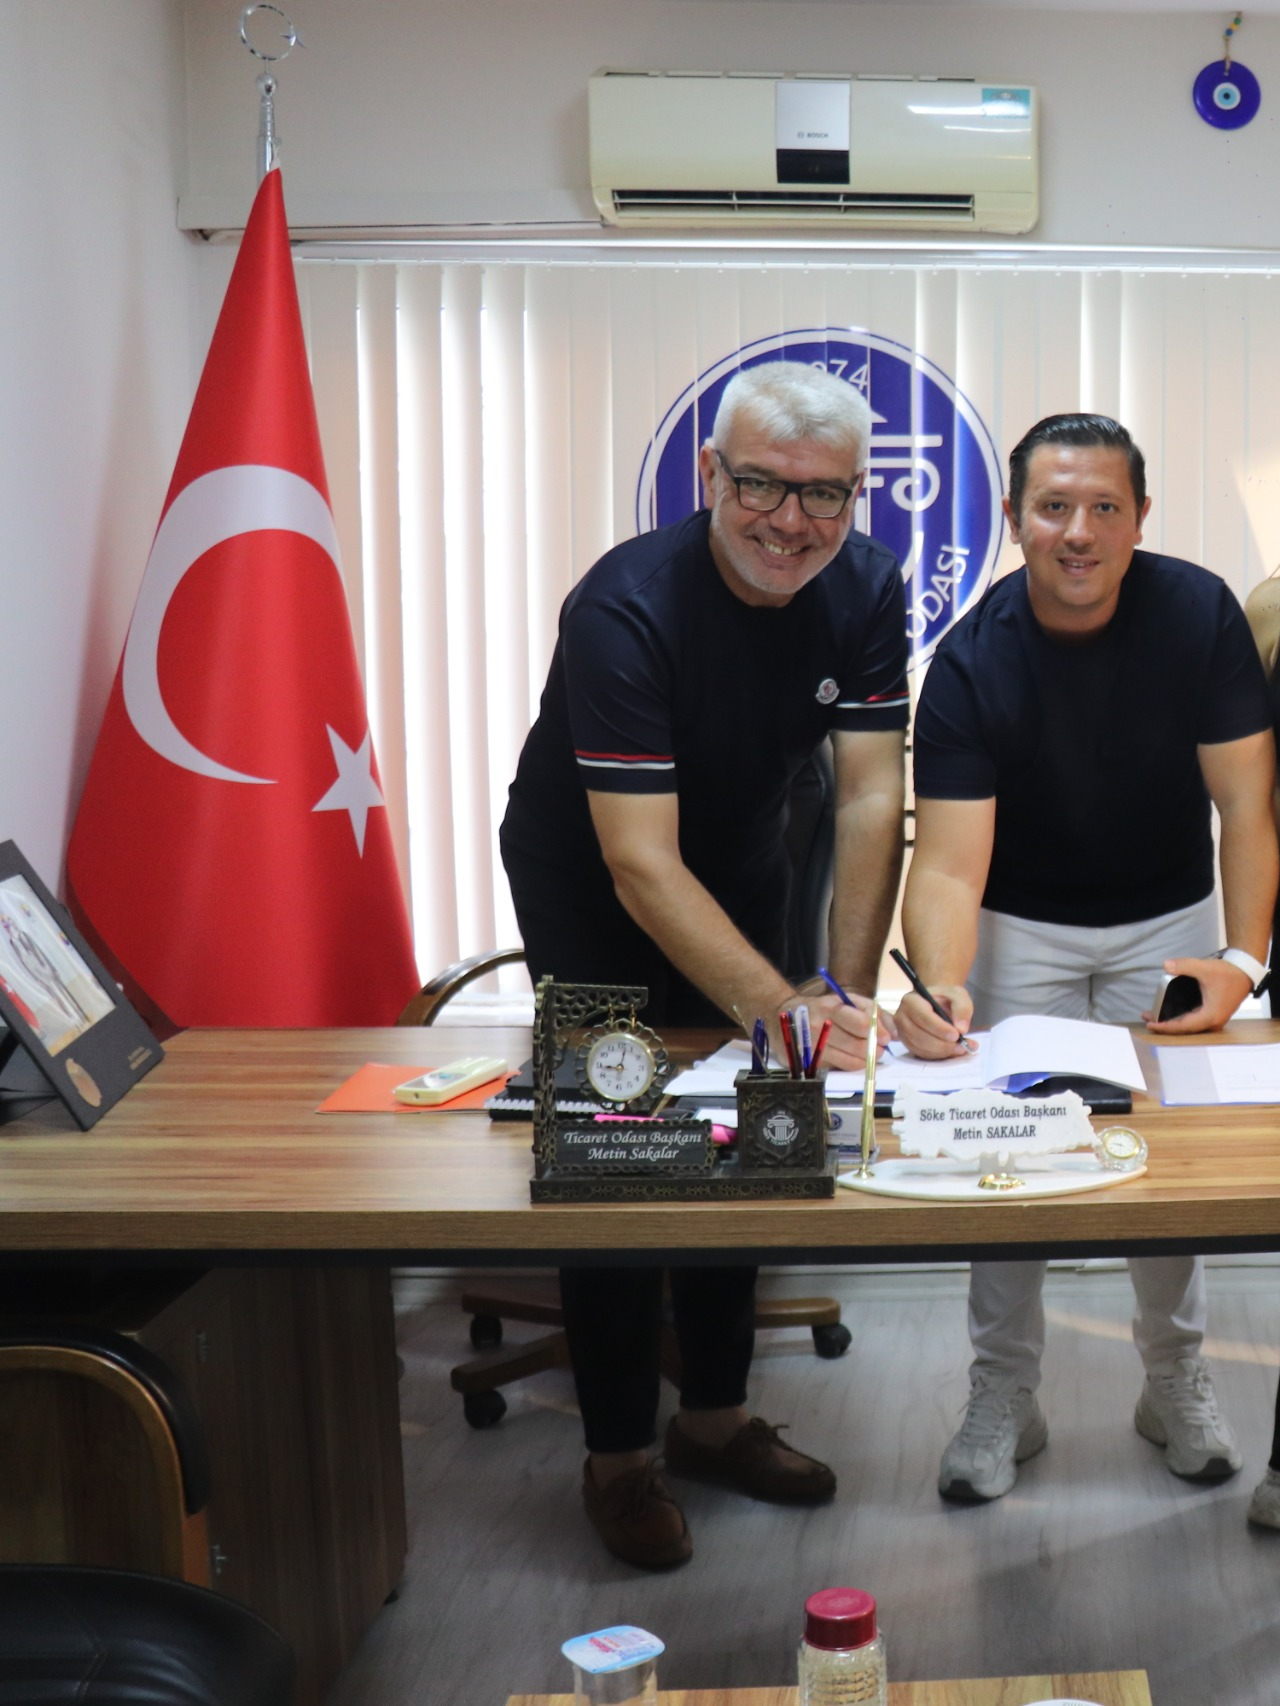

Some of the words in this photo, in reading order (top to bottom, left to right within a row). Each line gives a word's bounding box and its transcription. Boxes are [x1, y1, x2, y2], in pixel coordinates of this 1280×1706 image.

[905, 545, 970, 639] ODASI
[920, 1109, 946, 1121] Söke
[949, 1107, 987, 1120] Ticaret
[990, 1106, 1020, 1119] Odası
[1023, 1104, 1066, 1119] Başkanı
[563, 1131, 608, 1144] Ticaret
[611, 1130, 647, 1144] Odası
[650, 1129, 702, 1146] Başkanı
[953, 1127, 983, 1140] Metin
[986, 1125, 1036, 1138] SAKALAR
[587, 1148, 627, 1160] Metin
[629, 1146, 680, 1161] Sakalar
